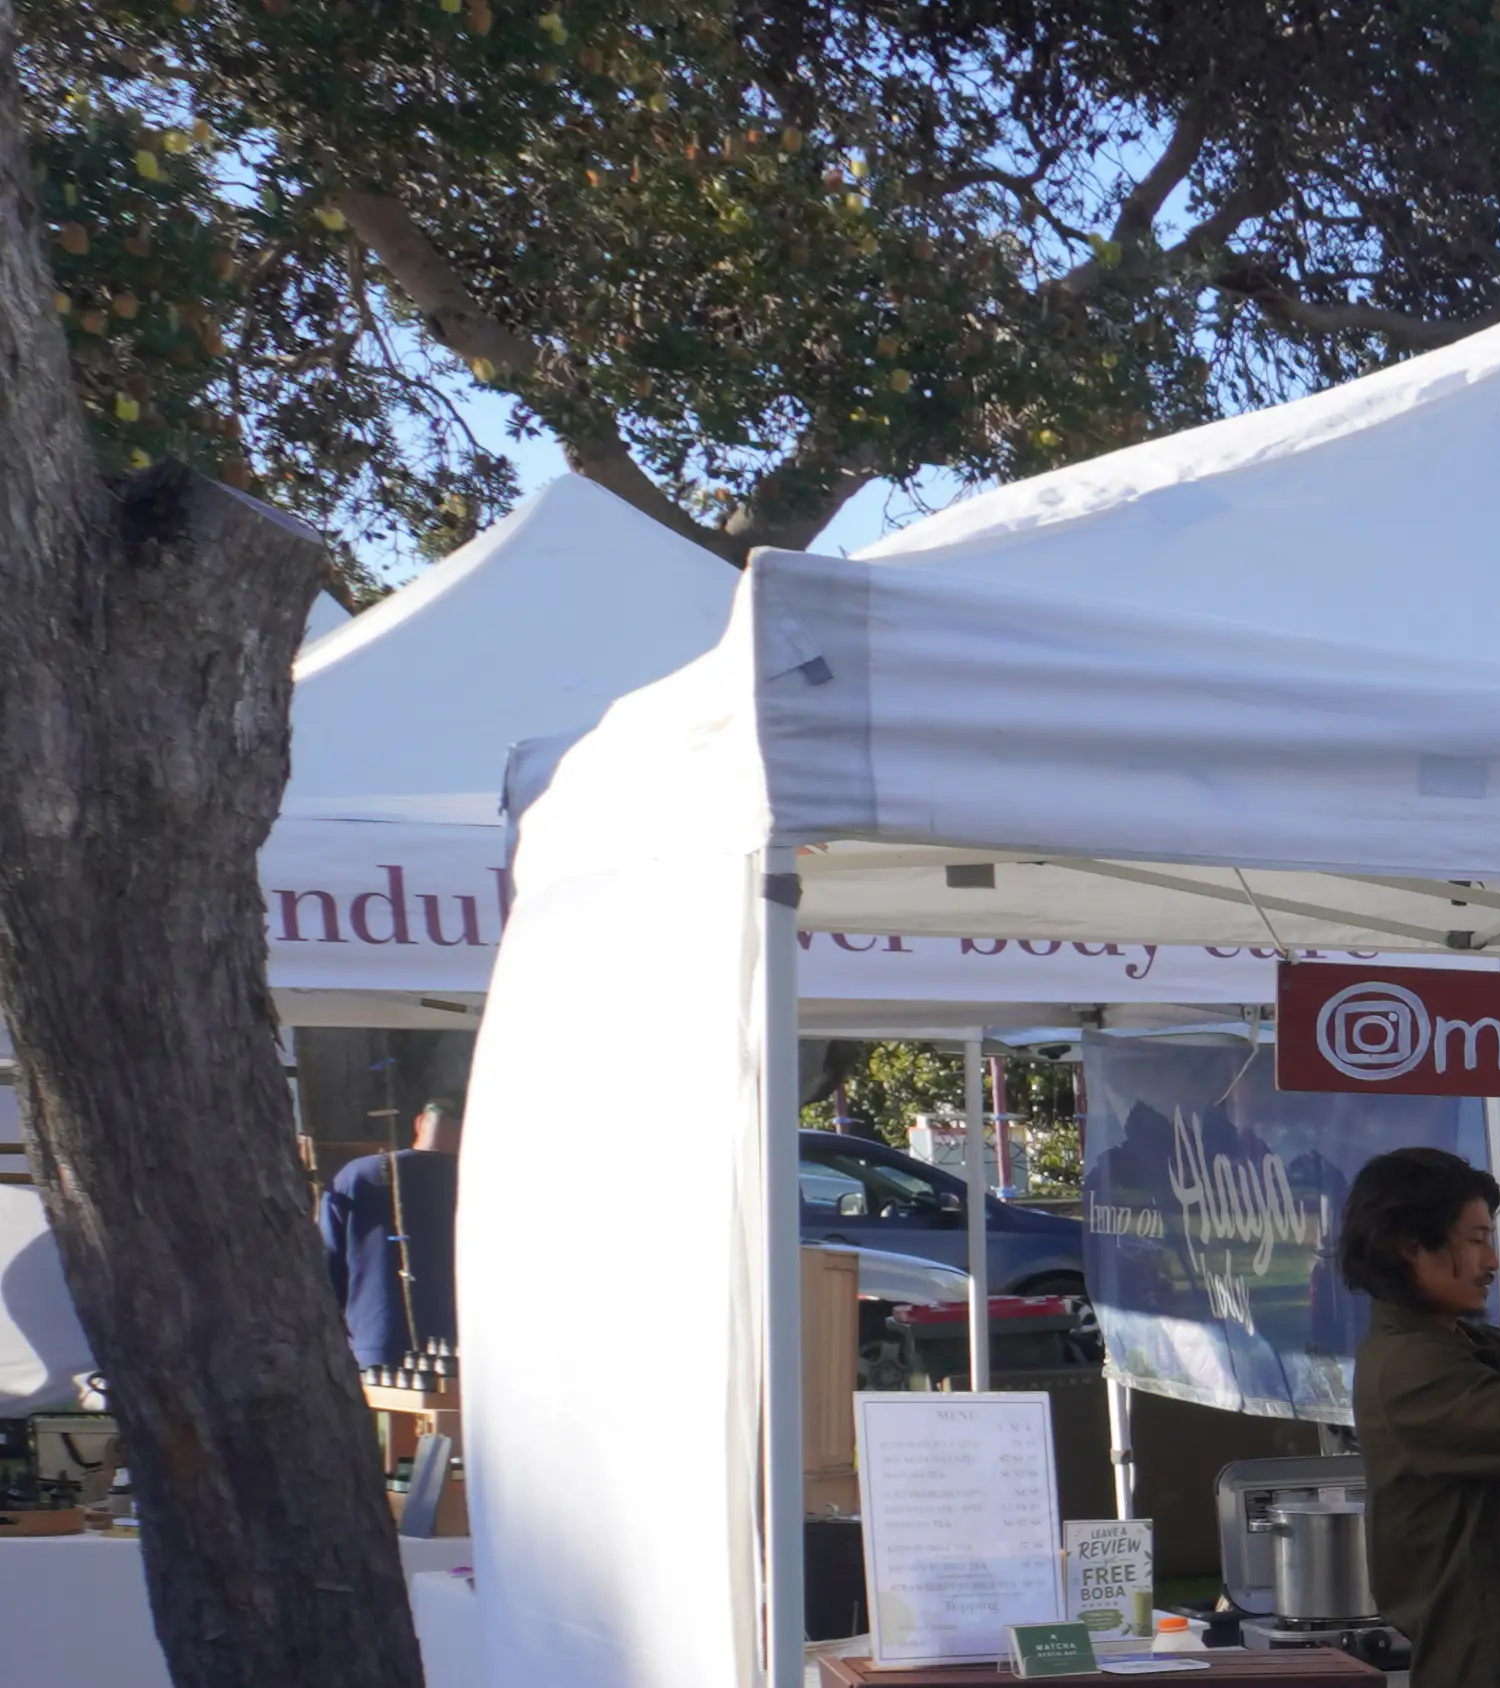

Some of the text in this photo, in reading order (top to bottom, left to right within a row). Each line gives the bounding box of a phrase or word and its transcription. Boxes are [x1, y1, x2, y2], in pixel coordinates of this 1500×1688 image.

[1091, 1527, 1128, 1540] LEAVE A
[1078, 1537, 1141, 1561] REVIEW
[1082, 1564, 1137, 1587] FREE
[1080, 1585, 1126, 1601] BOBA
[1036, 1642, 1077, 1651] MATCHA
